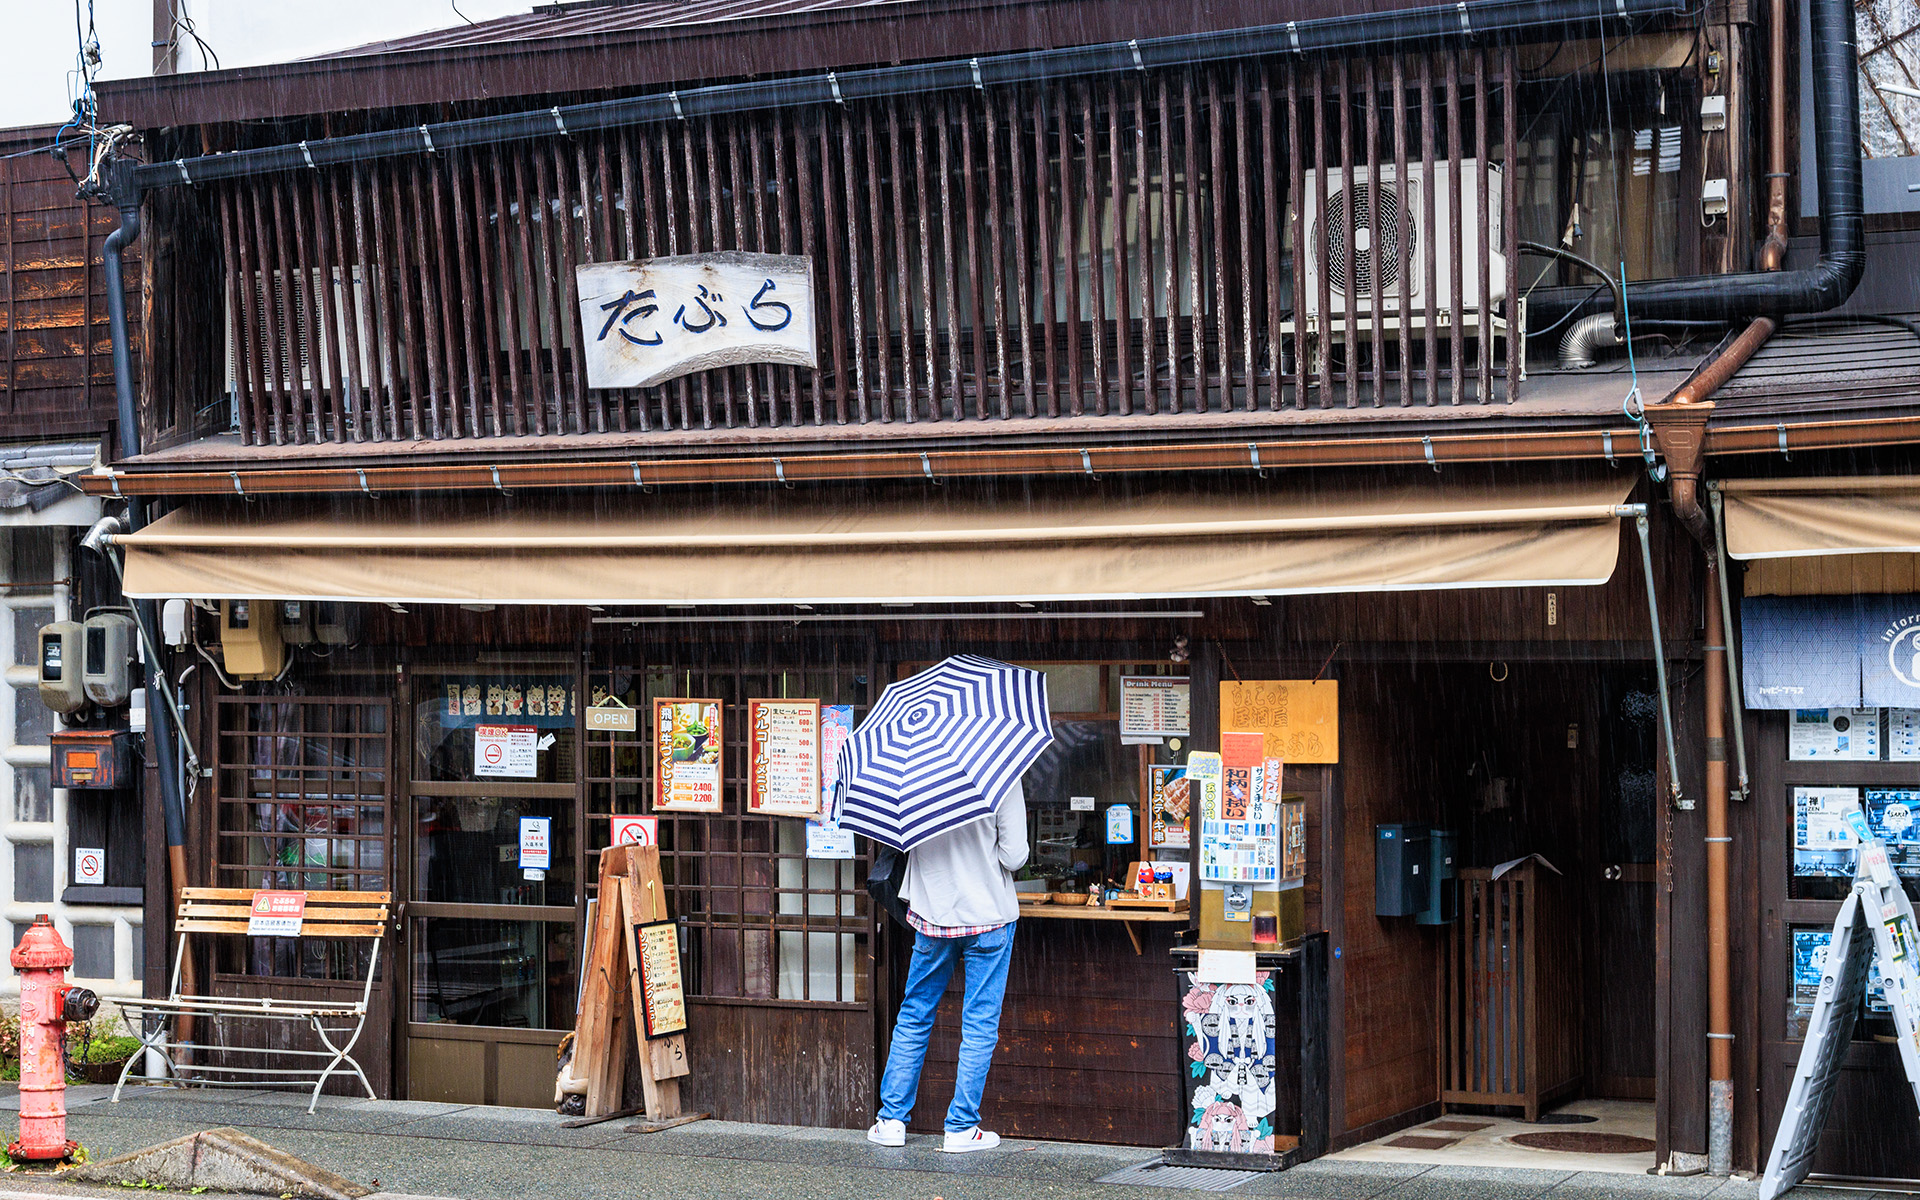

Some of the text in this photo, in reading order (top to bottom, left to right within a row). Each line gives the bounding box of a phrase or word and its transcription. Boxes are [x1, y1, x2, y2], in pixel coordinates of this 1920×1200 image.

[597, 279, 792, 346] たぶら
[1126, 680, 1149, 688] Drink
[1231, 685, 1289, 707] ちょこっと
[1759, 686, 1804, 695] ハッピープラス
[593, 713, 628, 725] OPEN
[1232, 706, 1289, 728] 居酒屋
[479, 727, 508, 736] 喫煙OK
[660, 707, 674, 803] 飛騨牛づくしセット
[755, 707, 769, 805] アルコールメニュー
[1266, 731, 1325, 757] たぶら
[1253, 767, 1264, 820] サラシ手拭い
[1809, 796, 1819, 806] 禅
[1153, 770, 1165, 842] 飛騨牛ステーキ串
[640, 932, 656, 1030] ソフトドリンクメニュー
